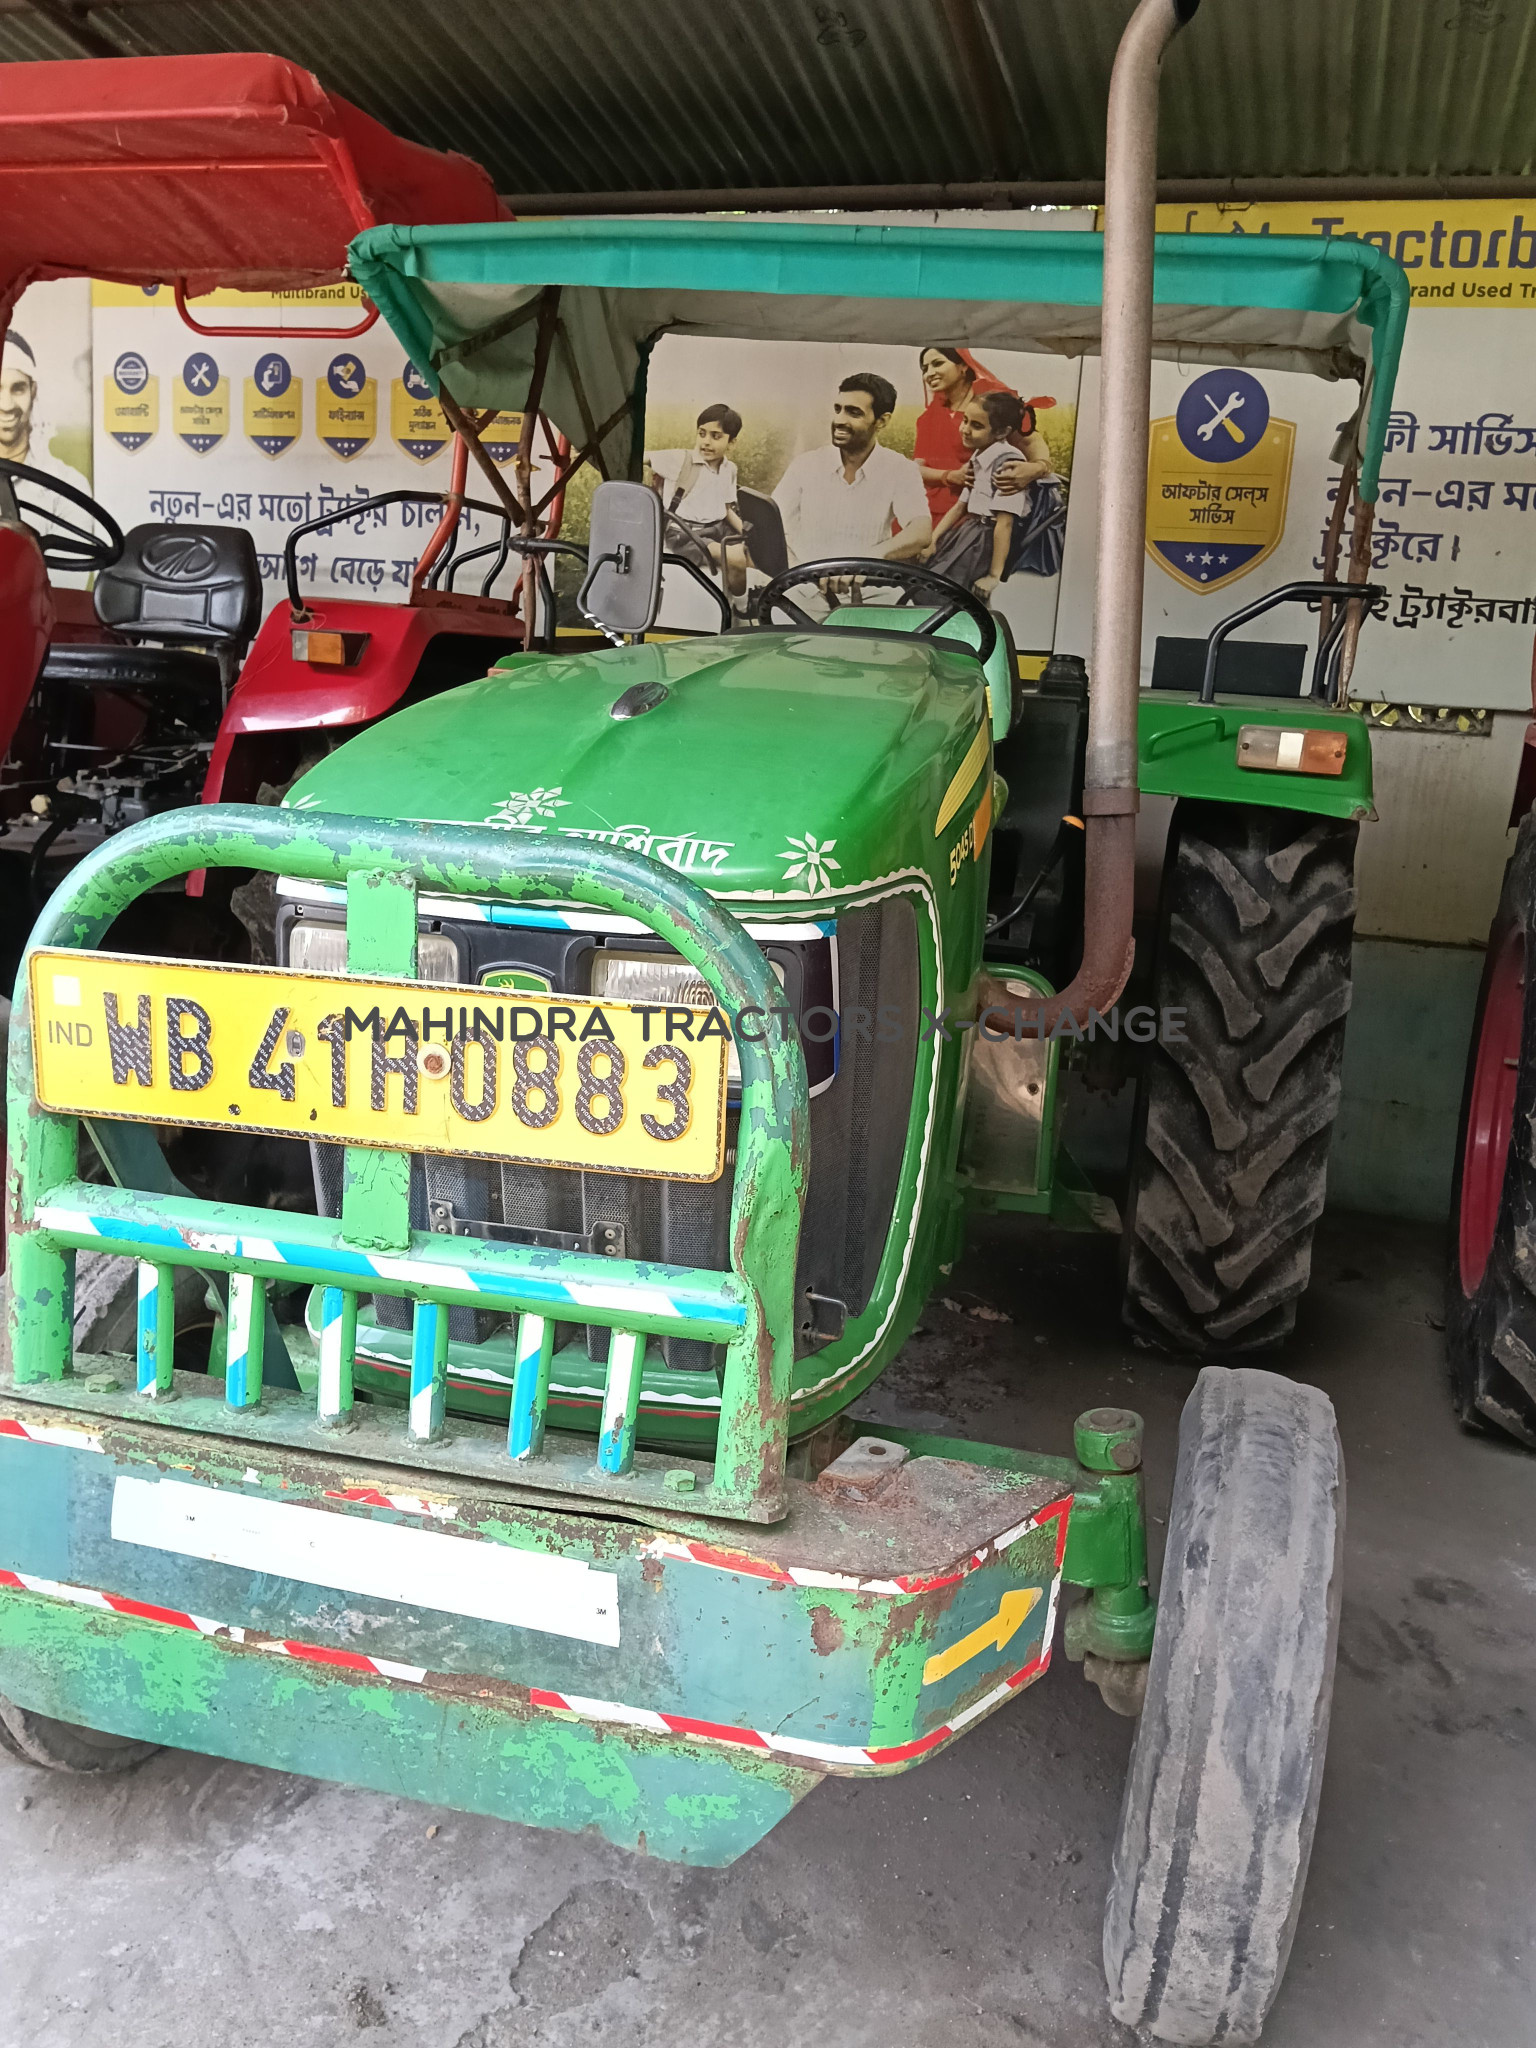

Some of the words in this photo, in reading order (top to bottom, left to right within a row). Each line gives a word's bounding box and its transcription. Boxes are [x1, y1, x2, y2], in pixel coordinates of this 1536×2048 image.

[1312, 216, 1536, 268] actorb
[350, 286, 369, 299] Us
[1462, 283, 1512, 298] Used
[1161, 479, 1220, 502] আফটার
[1502, 481, 1536, 511] ম
[259, 490, 312, 522] মতো
[1189, 506, 1235, 525] সার্ভিস
[330, 557, 385, 592] বেড়ে
[1393, 583, 1536, 629] ট্র্যাক্টরবা
[48, 1020, 93, 1047] IND
[102, 991, 216, 1091] WB
